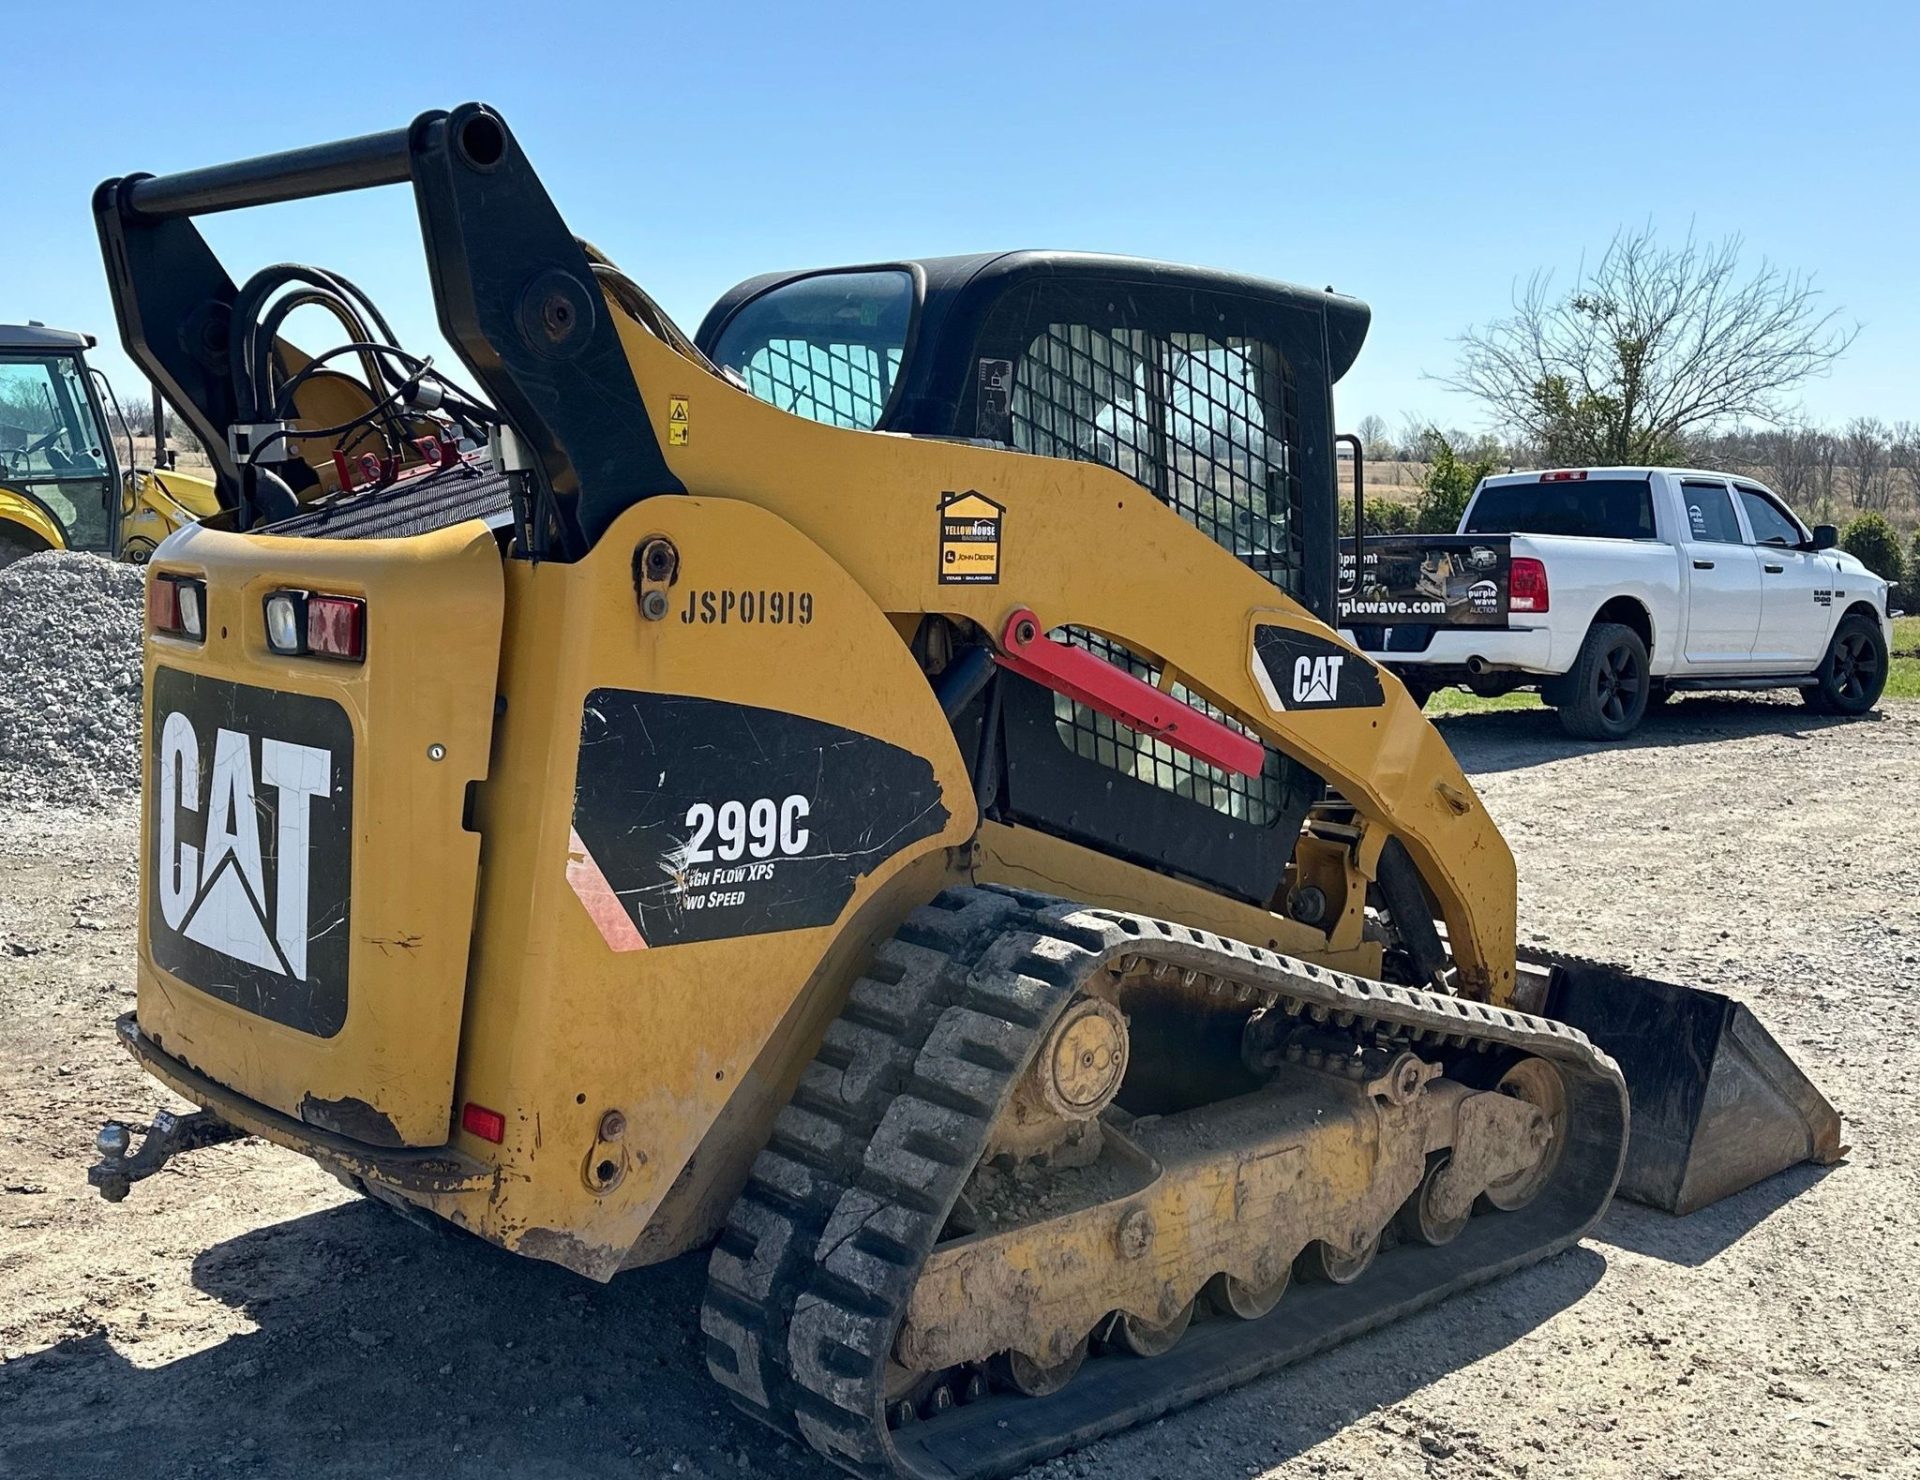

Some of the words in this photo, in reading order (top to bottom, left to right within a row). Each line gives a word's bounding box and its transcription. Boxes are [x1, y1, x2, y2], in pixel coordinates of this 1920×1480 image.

[945, 524, 995, 535] YELLOWHOUSE
[958, 553, 974, 561] JOHN
[975, 553, 994, 561] DEERE
[1468, 588, 1497, 599] purple
[681, 591, 813, 624] JSP01919
[1470, 606, 1497, 614] AUCTION
[1293, 655, 1344, 702] CAT
[685, 795, 809, 863] 299C
[159, 711, 331, 981] CAT
[686, 869, 710, 887] IGH
[712, 868, 746, 885] FLOW
[747, 863, 775, 882] XPS
[685, 894, 706, 910] WO
[707, 891, 745, 908] SPEED
